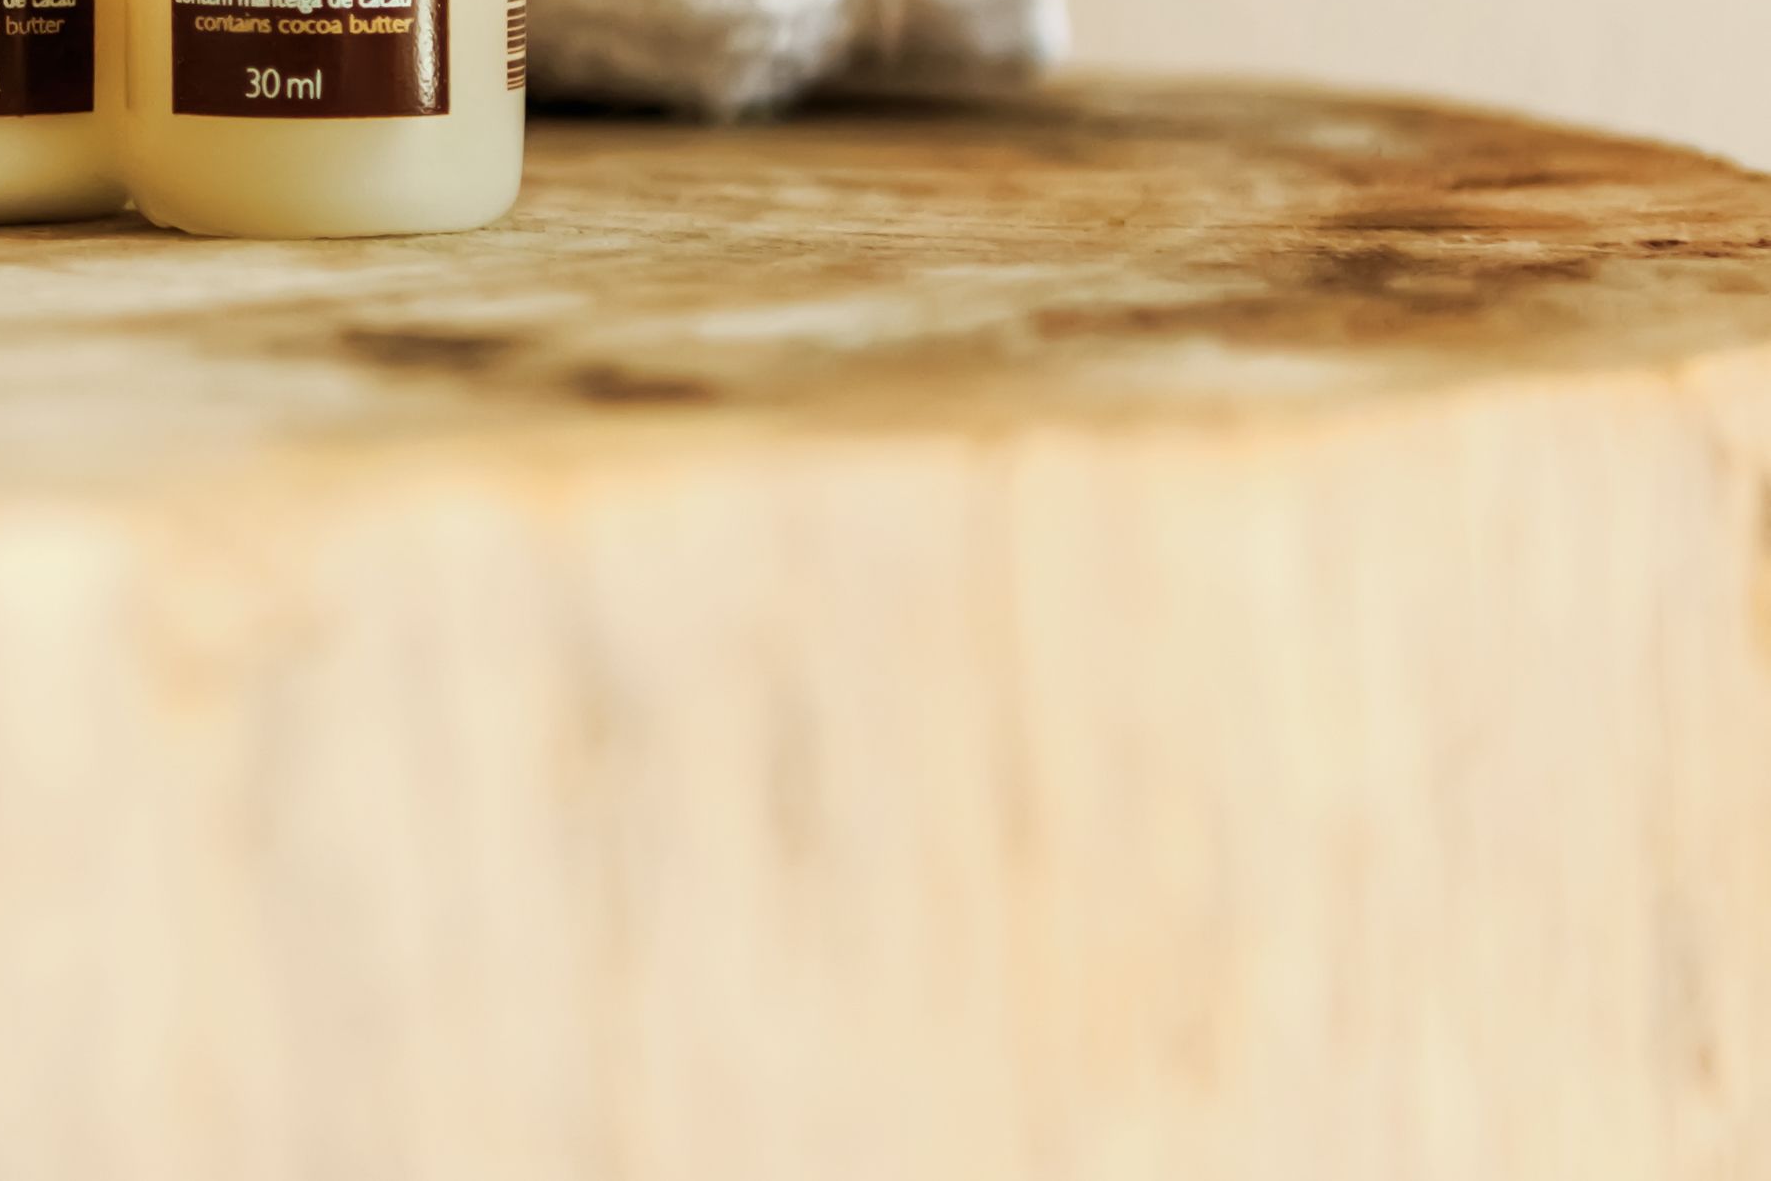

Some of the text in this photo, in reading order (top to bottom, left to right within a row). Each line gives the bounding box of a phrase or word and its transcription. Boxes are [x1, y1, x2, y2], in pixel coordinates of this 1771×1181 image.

[6, 16, 65, 35] butter
[195, 12, 414, 34] contains cocoa butter
[246, 68, 322, 98] 30 ml
